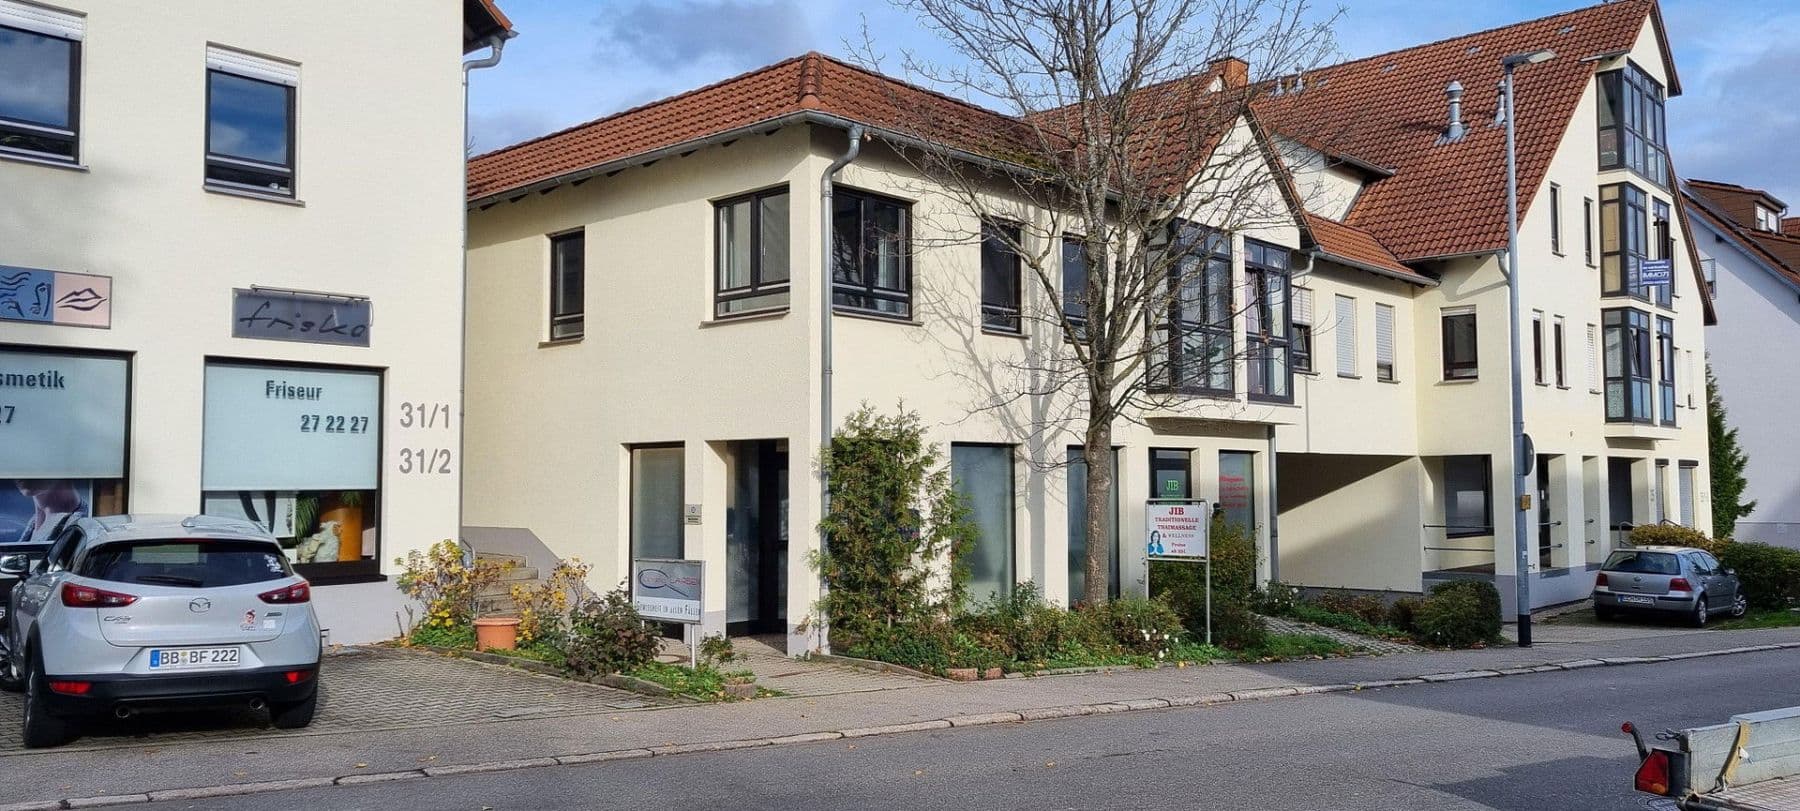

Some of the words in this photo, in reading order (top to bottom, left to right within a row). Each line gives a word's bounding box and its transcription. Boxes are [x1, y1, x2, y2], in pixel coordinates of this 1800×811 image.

[239, 301, 368, 338] frisko
[265, 380, 322, 400] Friseur
[301, 415, 320, 432] 27
[325, 416, 345, 432] 22
[350, 417, 369, 433] 27
[400, 402, 449, 428] 31/1
[399, 448, 451, 473] 31/2
[1166, 480, 1179, 491] JIB
[1168, 507, 1184, 515] JIB
[161, 652, 180, 665] BB
[190, 650, 208, 662] BF
[211, 649, 238, 662] 222
